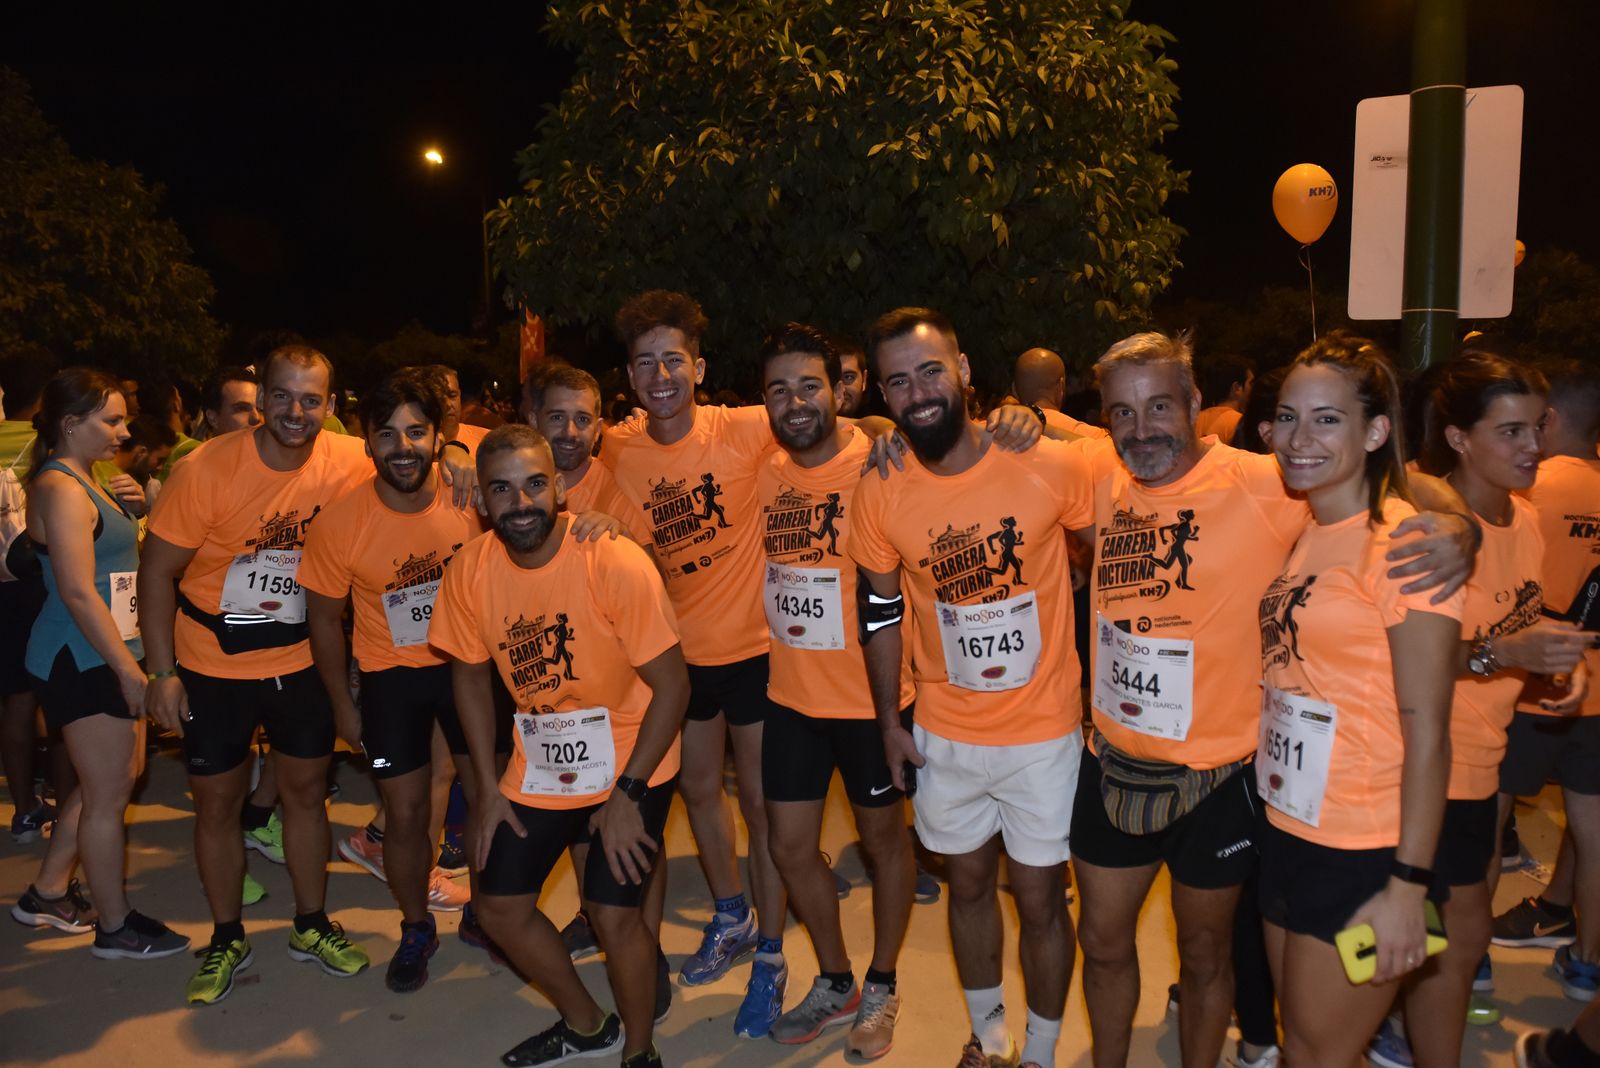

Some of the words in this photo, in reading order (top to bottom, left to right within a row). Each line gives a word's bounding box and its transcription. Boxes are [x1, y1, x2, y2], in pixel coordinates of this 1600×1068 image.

[652, 494, 694, 526] CARRERA
[766, 508, 812, 531] CARRERA
[652, 516, 702, 546] NOCTURNA
[1101, 529, 1157, 559] CARRERA
[931, 543, 987, 582] CARRERA
[247, 571, 301, 596] 11599
[935, 570, 994, 603] NOCTURNA
[411, 604, 433, 622] 89
[774, 592, 824, 618] 14345
[957, 629, 1025, 658] 16743
[1111, 660, 1161, 698] 5444
[1152, 701, 1183, 711] GARCIA
[541, 740, 590, 764] 7202
[581, 761, 608, 771] ACOSTA
